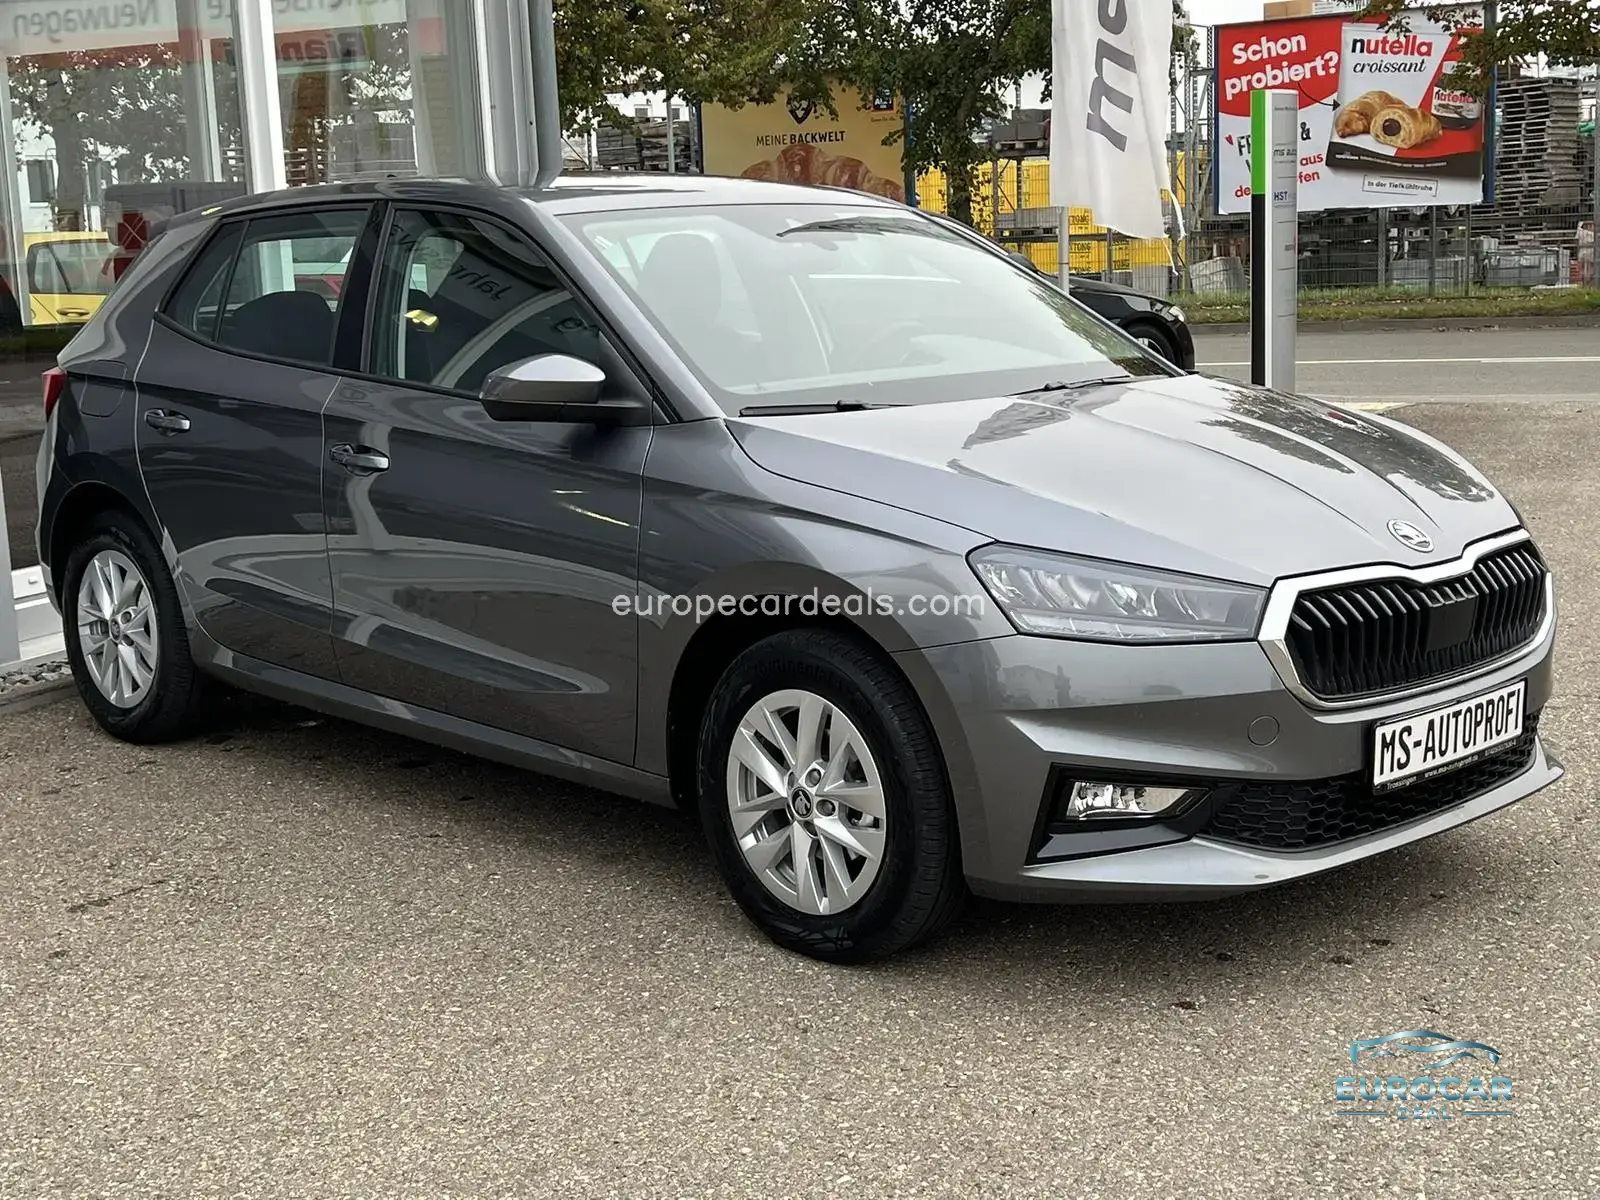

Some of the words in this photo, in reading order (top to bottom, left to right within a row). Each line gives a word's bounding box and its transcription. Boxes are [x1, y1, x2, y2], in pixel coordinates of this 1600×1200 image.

[1232, 34, 1307, 65] Schon
[1351, 34, 1433, 57] nutella
[1224, 51, 1340, 101] probiert?
[1352, 56, 1427, 74] croissant
[756, 134, 788, 147] MEINE
[789, 130, 846, 145] BACKWELT
[1379, 687, 1522, 776] MS-AUTOPROFI
